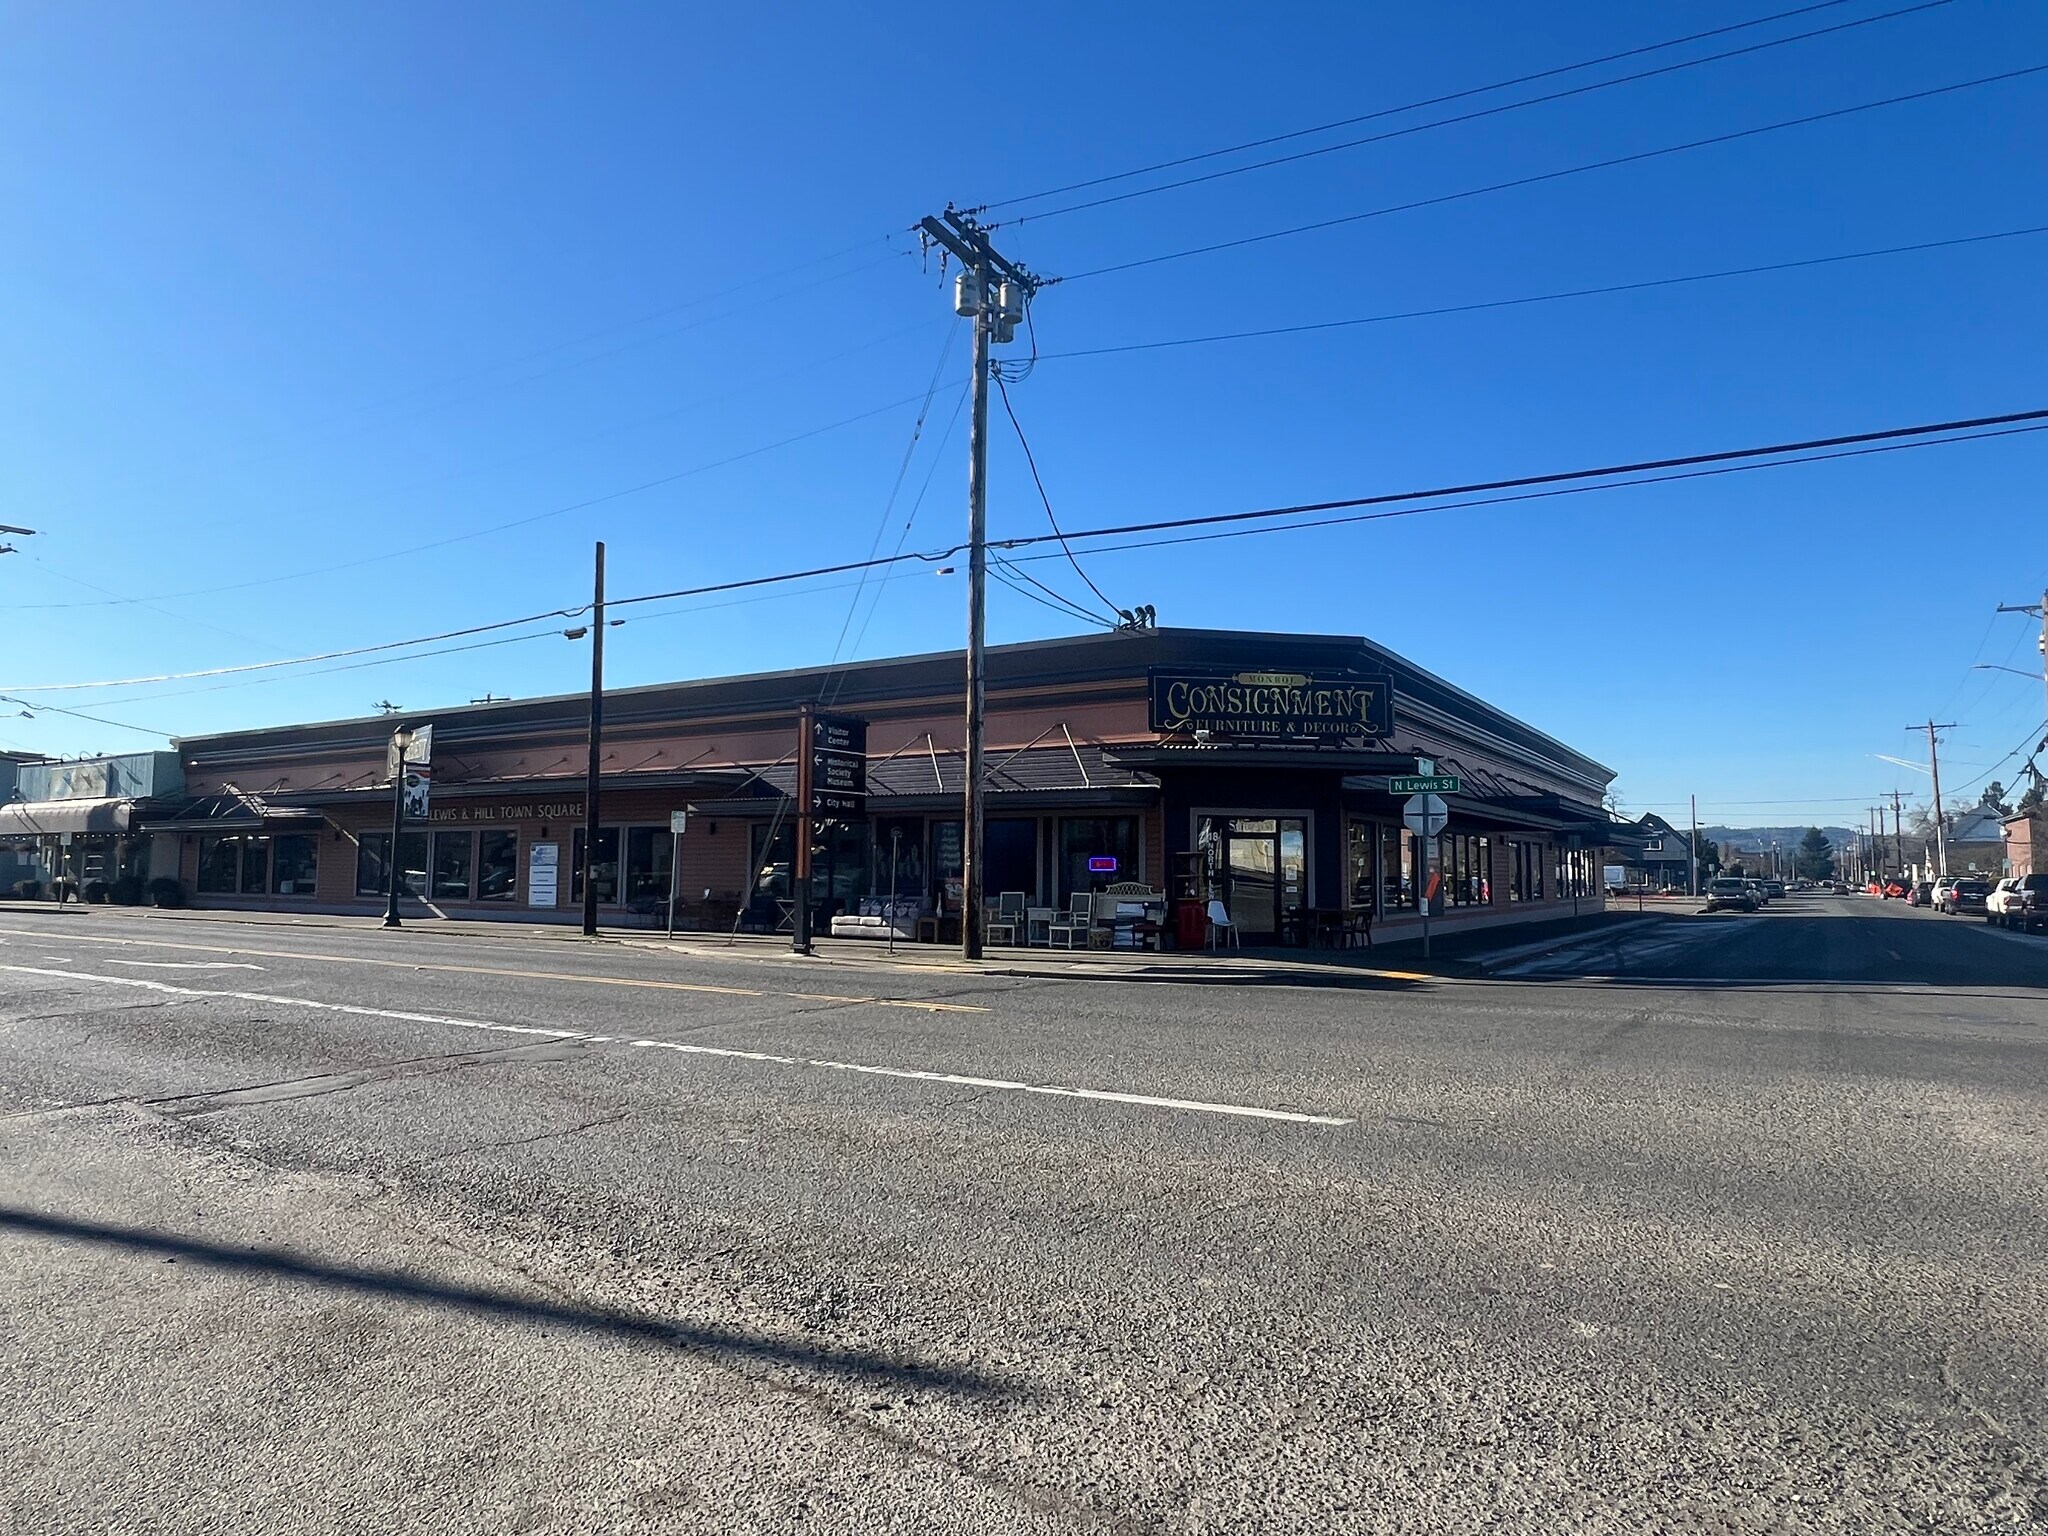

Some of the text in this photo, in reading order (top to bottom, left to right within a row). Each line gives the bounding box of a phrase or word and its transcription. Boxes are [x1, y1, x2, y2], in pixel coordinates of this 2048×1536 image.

[1167, 682, 1374, 723] CONSIGNMENT
[828, 726, 849, 736] Visitor
[1196, 719, 1349, 733] FURNITURE & DECOR
[828, 736, 850, 746] Center
[827, 758, 859, 768] Historical
[827, 767, 852, 779] Society
[827, 777, 854, 787] Museum
[1394, 779, 1454, 791] N Lewis St
[827, 798, 840, 809] City
[429, 803, 584, 821] LEWIS & HILL TOWN SQUARE
